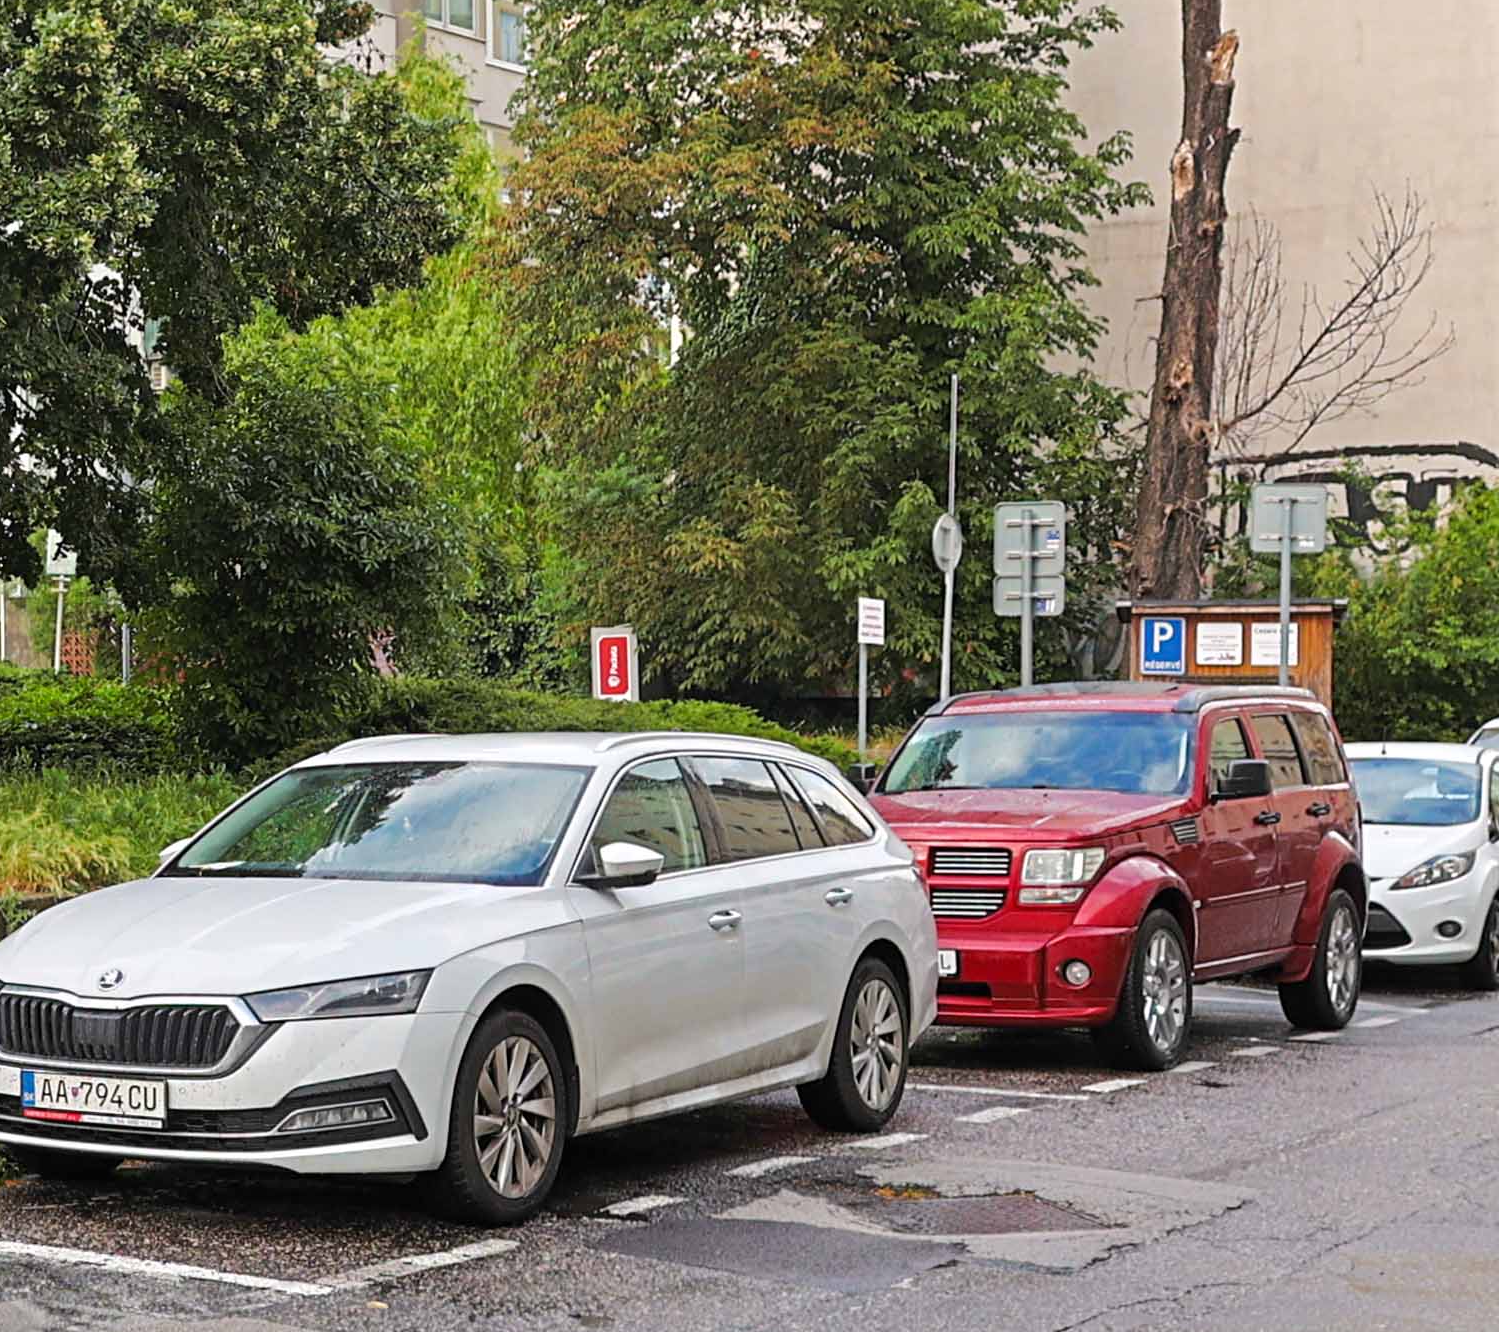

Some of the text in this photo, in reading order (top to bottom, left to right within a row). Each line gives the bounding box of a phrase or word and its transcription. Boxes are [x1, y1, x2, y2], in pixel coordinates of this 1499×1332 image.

[1153, 622, 1174, 653] P
[40, 1078, 69, 1105] AA
[79, 1080, 158, 1111] 794CU
